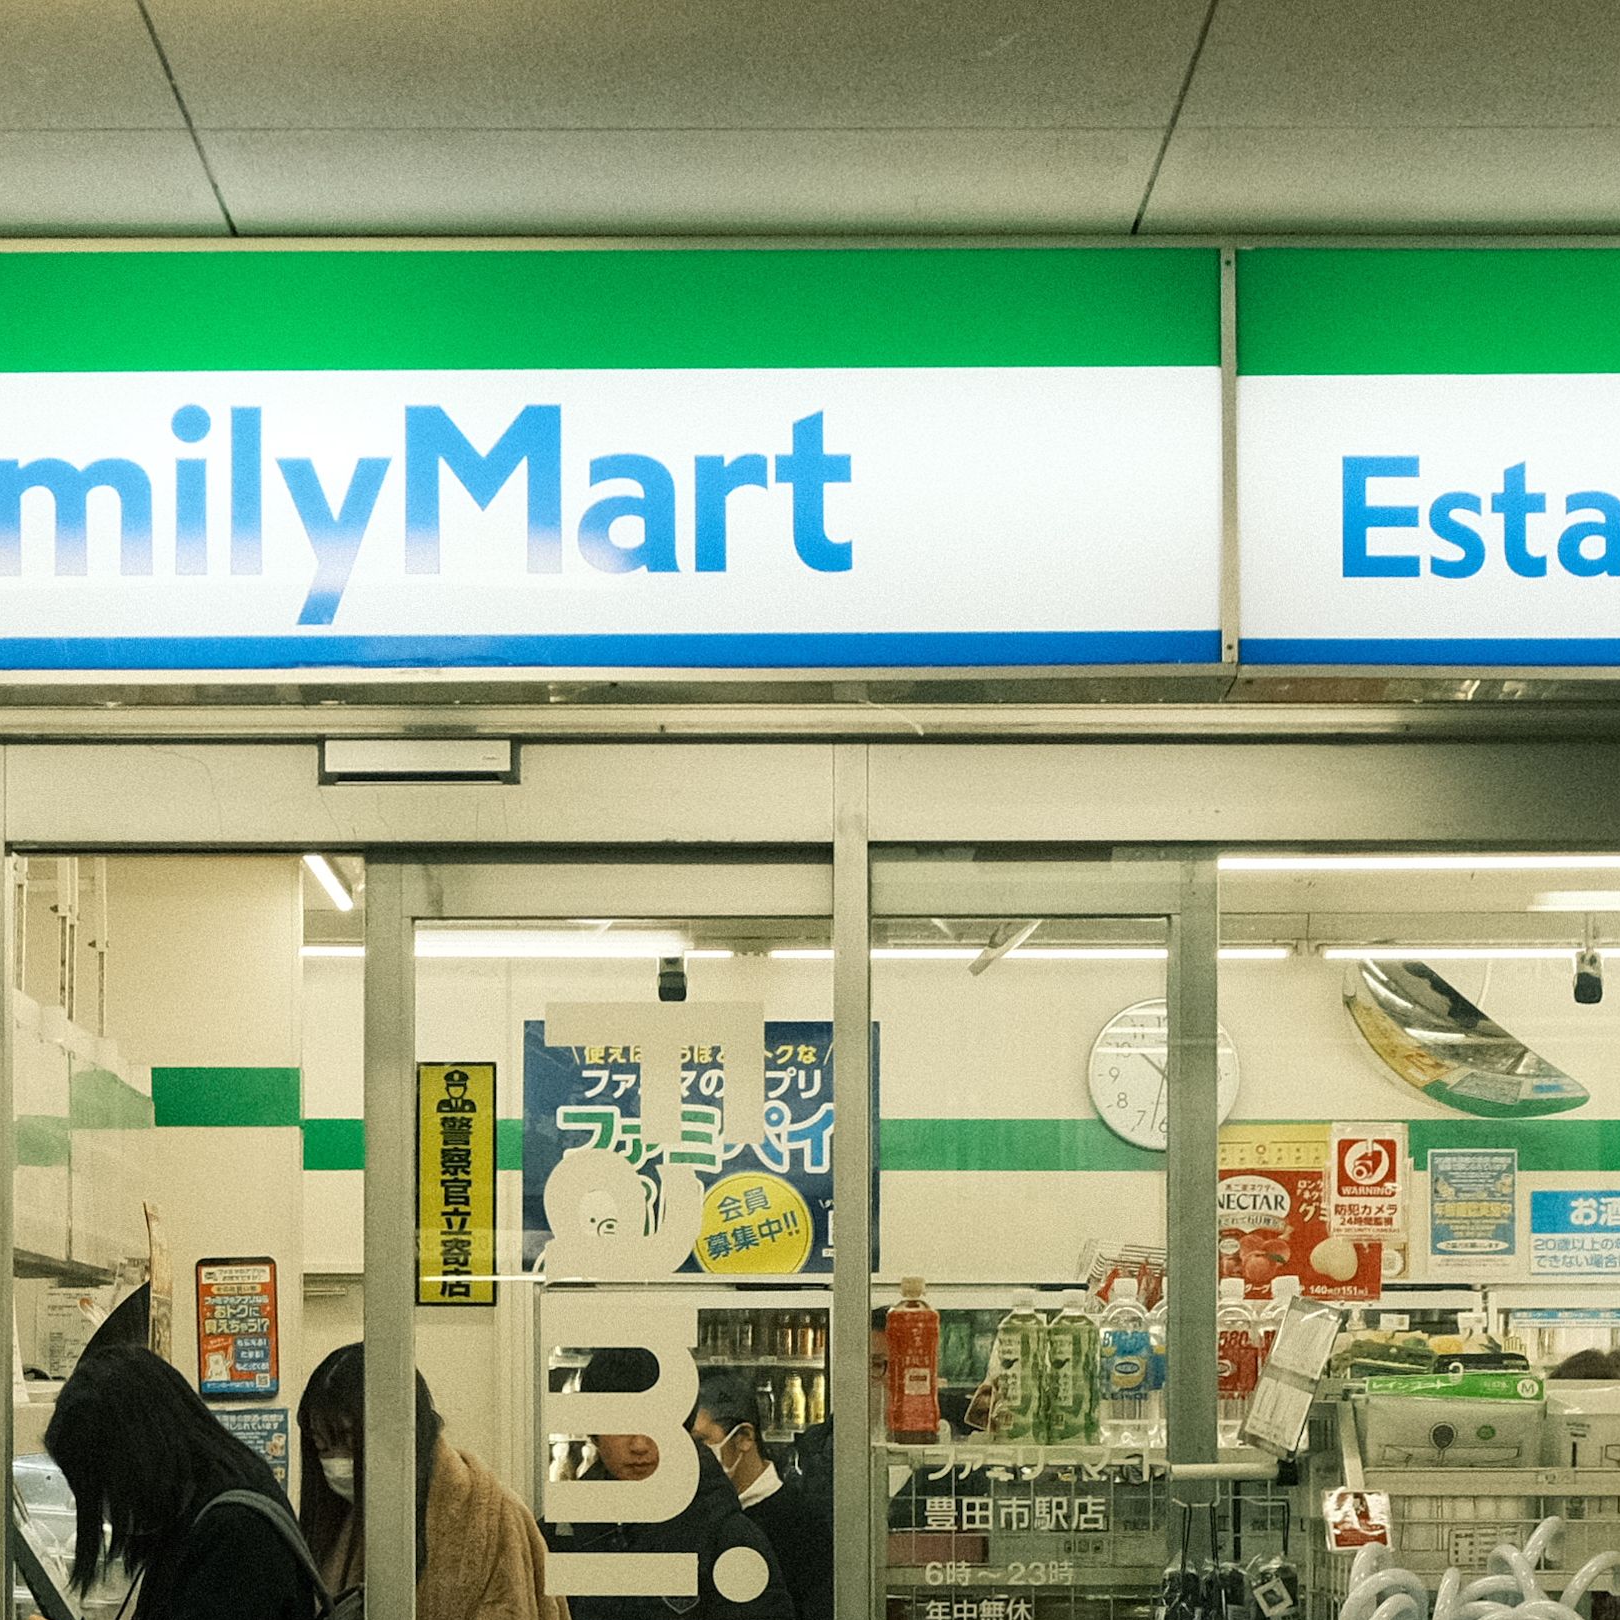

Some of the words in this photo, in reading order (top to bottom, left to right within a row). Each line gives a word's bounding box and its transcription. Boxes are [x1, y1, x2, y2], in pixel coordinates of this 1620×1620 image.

[1108, 1066, 1120, 1083] 9
[1117, 1092, 1129, 1109] 8
[1136, 1110, 1147, 1127] 7
[1341, 1187, 1391, 1198] WARNING
[439, 1116, 473, 1298] 警察官立寄店
[716, 1187, 772, 1224] 会員
[1333, 1204, 1400, 1217] 防犯カメラ
[1522, 1384, 1536, 1395] M
[924, 1497, 1106, 1532] 豊田市駅店
